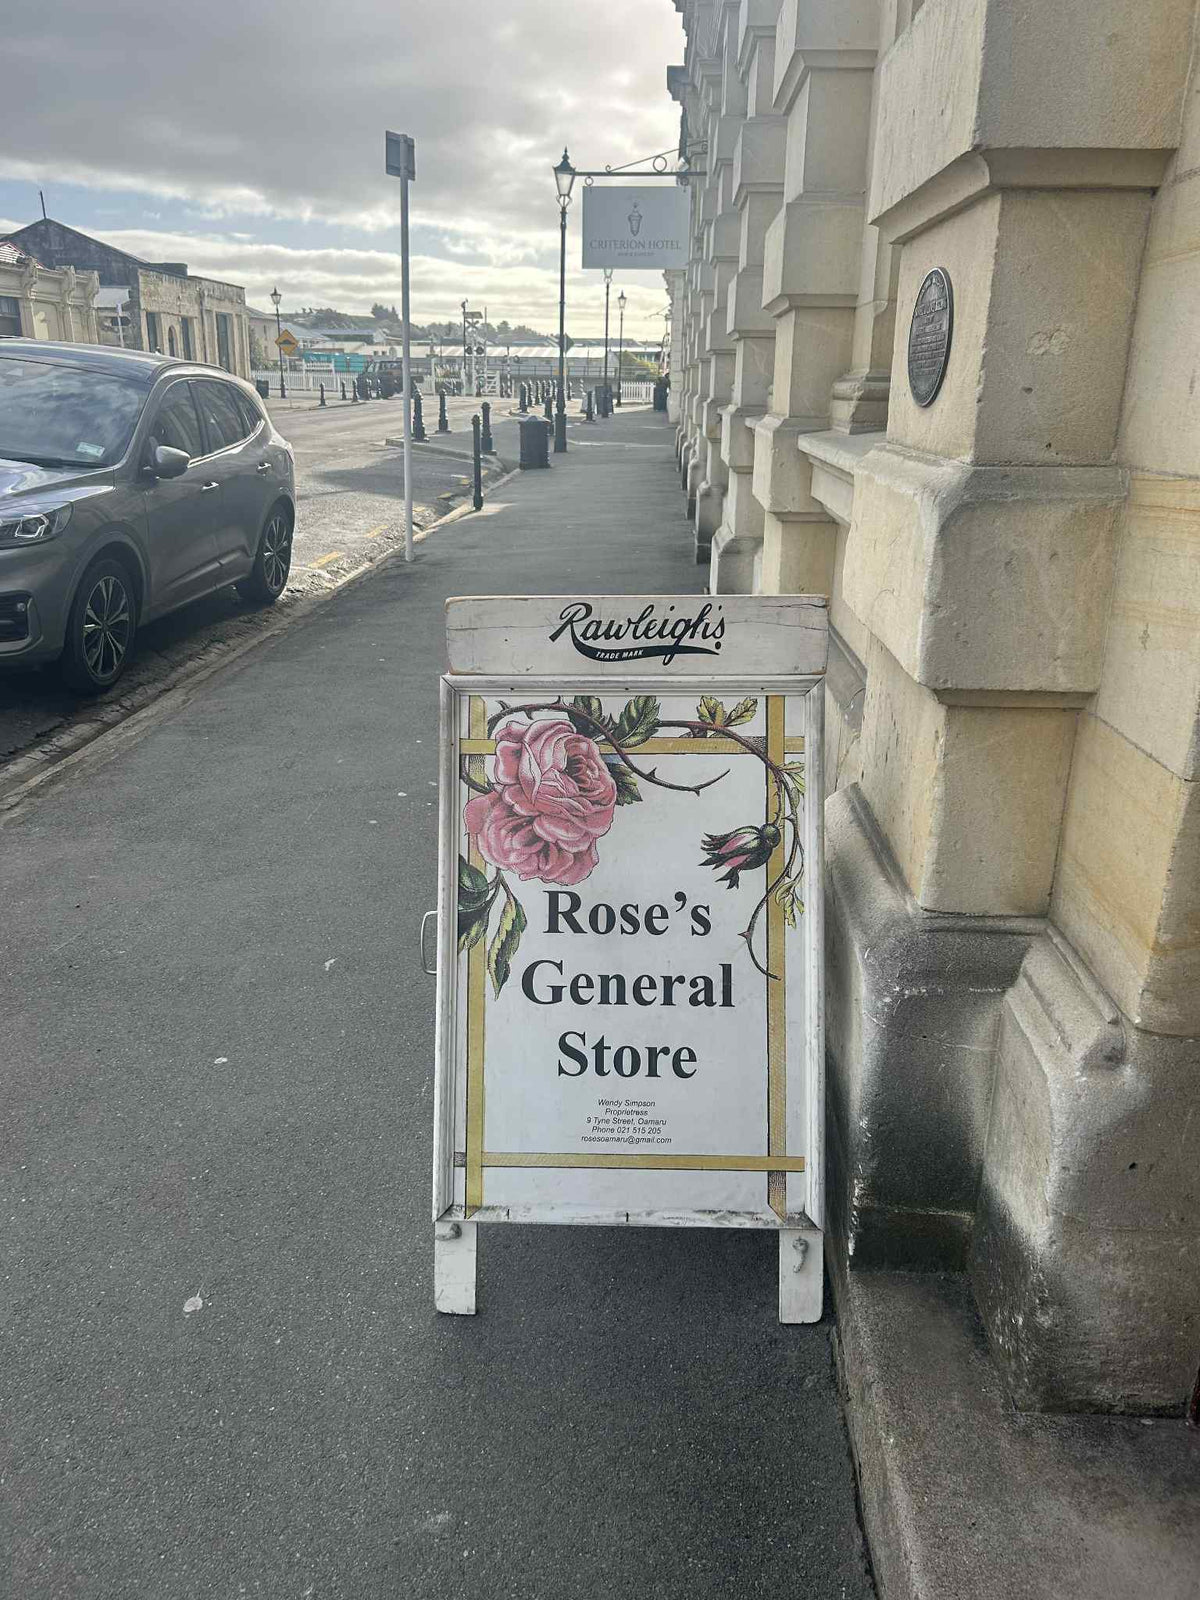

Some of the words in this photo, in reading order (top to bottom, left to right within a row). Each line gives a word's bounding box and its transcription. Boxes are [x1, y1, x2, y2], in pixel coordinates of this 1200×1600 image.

[589, 240, 647, 250] CRITERION
[648, 240, 682, 250] HOTEL
[548, 602, 726, 666] Rawleigh's
[595, 651, 620, 660] TRADE
[622, 649, 645, 658] MARK
[543, 890, 712, 936] Rose's
[521, 959, 736, 1008] General
[558, 1031, 698, 1079] Store
[597, 1099, 622, 1108] Wendy
[624, 1099, 656, 1108] Simpson
[604, 1108, 649, 1117] Proprietress
[586, 1116, 592, 1124] 9
[593, 1116, 610, 1126] Tyne
[611, 1117, 636, 1126] Street,
[637, 1117, 667, 1126] Oamaru
[591, 1125, 615, 1134] Phone
[616, 1126, 630, 1134] 021
[632, 1126, 646, 1135] 515
[647, 1126, 662, 1135] 205
[581, 1135, 672, 1145] rosesoamaru@gmail.com
